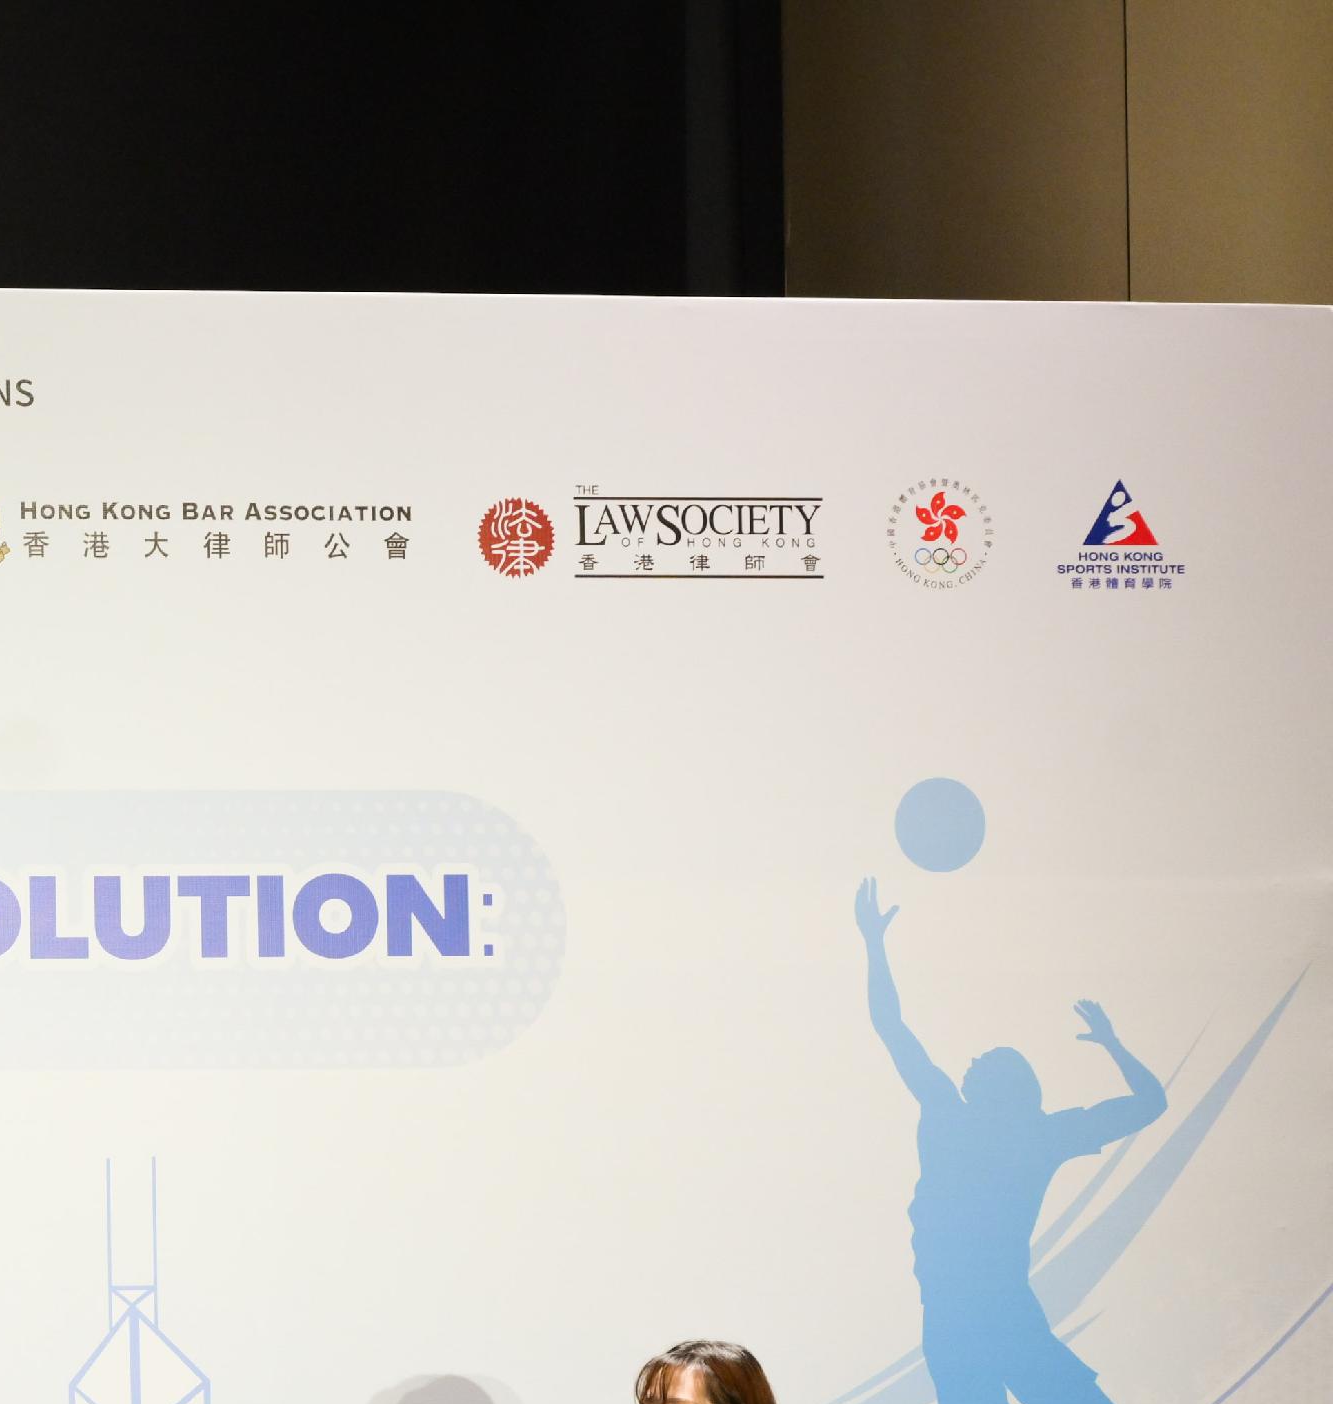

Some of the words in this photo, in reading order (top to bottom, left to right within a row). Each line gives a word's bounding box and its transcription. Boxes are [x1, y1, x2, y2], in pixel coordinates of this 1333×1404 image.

[576, 485, 599, 495] THE
[20, 501, 91, 520] HONG
[101, 501, 171, 521] KONG
[182, 502, 235, 521] BAR
[244, 502, 413, 522] ASSOCIATION
[23, 532, 411, 560] 香港大律師公會
[622, 537, 644, 548] OF
[688, 537, 742, 548] HONG
[762, 537, 816, 549] KONG
[578, 553, 822, 572] 香港律師會
[1078, 552, 1119, 562] HONG
[1124, 552, 1164, 562] KONG
[895, 558, 921, 583] HONG
[959, 560, 986, 585] CHINA
[1057, 565, 1112, 574] SPORTS
[1117, 565, 1186, 574] INSTITUTE
[1071, 577, 1173, 590] 香港體育學院
